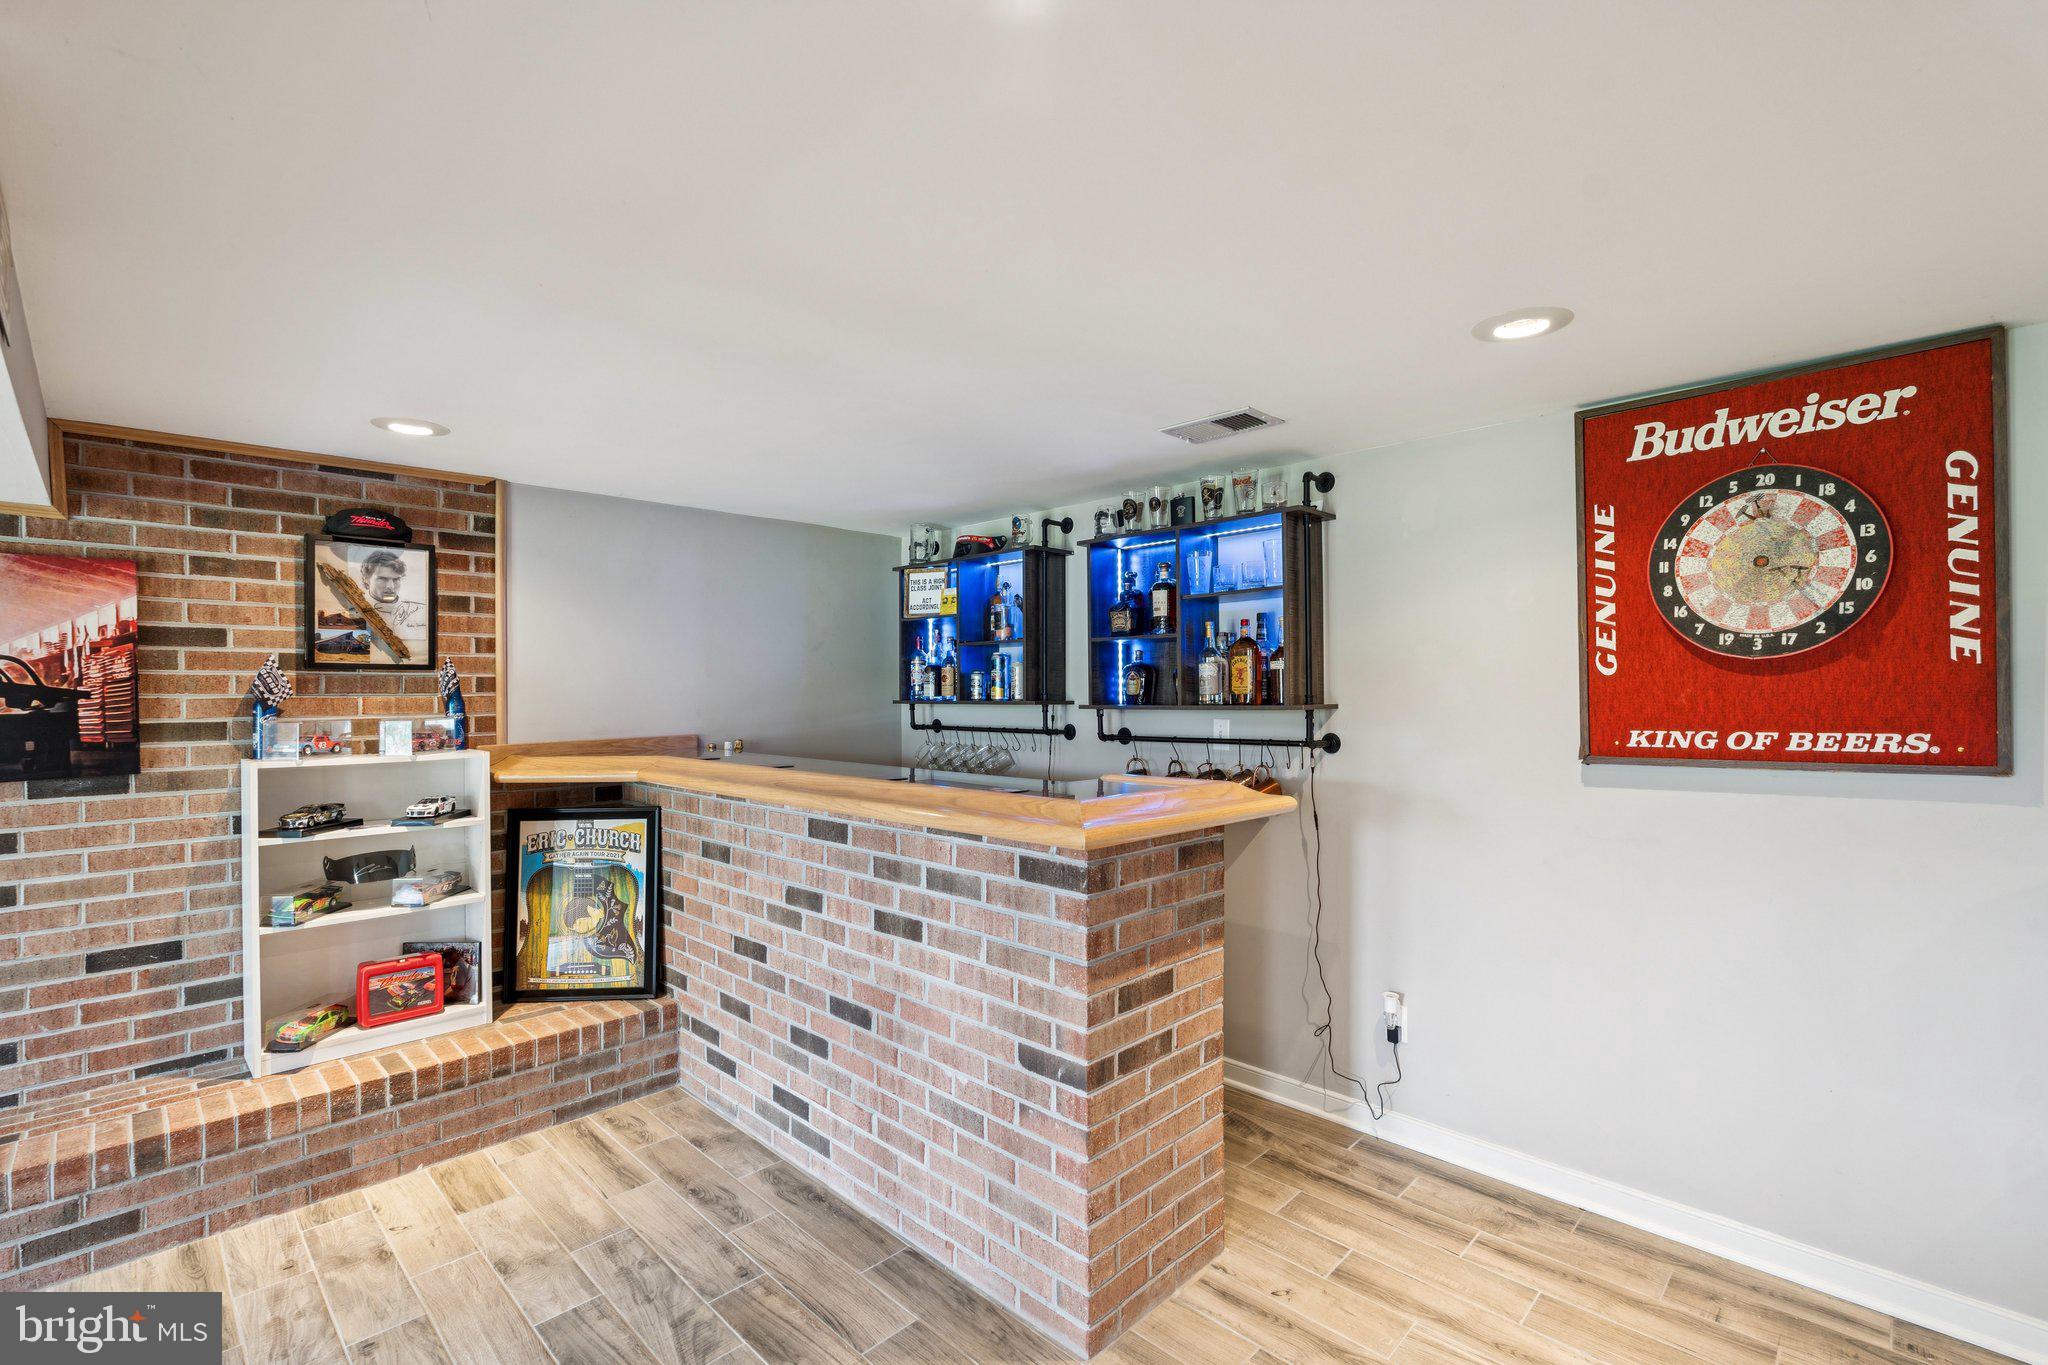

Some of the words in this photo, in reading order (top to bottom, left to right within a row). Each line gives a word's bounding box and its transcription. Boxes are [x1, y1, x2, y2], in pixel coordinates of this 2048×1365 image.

[1626, 385, 1918, 463] Budweiser
[1755, 473, 1776, 487] 20
[1795, 474, 1801, 487] 1
[1728, 481, 1738, 494] 5
[1818, 482, 1836, 496] 18
[1699, 495, 1714, 508] 12
[1844, 499, 1856, 512] 4
[1680, 514, 1691, 527] 9
[1860, 524, 1876, 537] 13
[1663, 538, 1678, 550] 14
[1864, 550, 1878, 562] 6
[1945, 449, 1983, 665] GENUINE
[1658, 562, 1670, 574] 11
[1594, 503, 1618, 676] GENUINE
[1855, 577, 1874, 590] 10
[1662, 585, 1673, 597] 8
[1673, 605, 1688, 618] 16
[1838, 601, 1855, 614] 15
[1694, 623, 1706, 636] 7
[1815, 622, 1826, 634] 2
[1718, 632, 1734, 646] 19
[1752, 638, 1762, 650] 3
[1781, 632, 1798, 646] 17
[1626, 730, 1719, 749] KING
[1726, 731, 1780, 750] OF
[526, 829, 567, 854] ERIC
[574, 828, 642, 853] CHURCH
